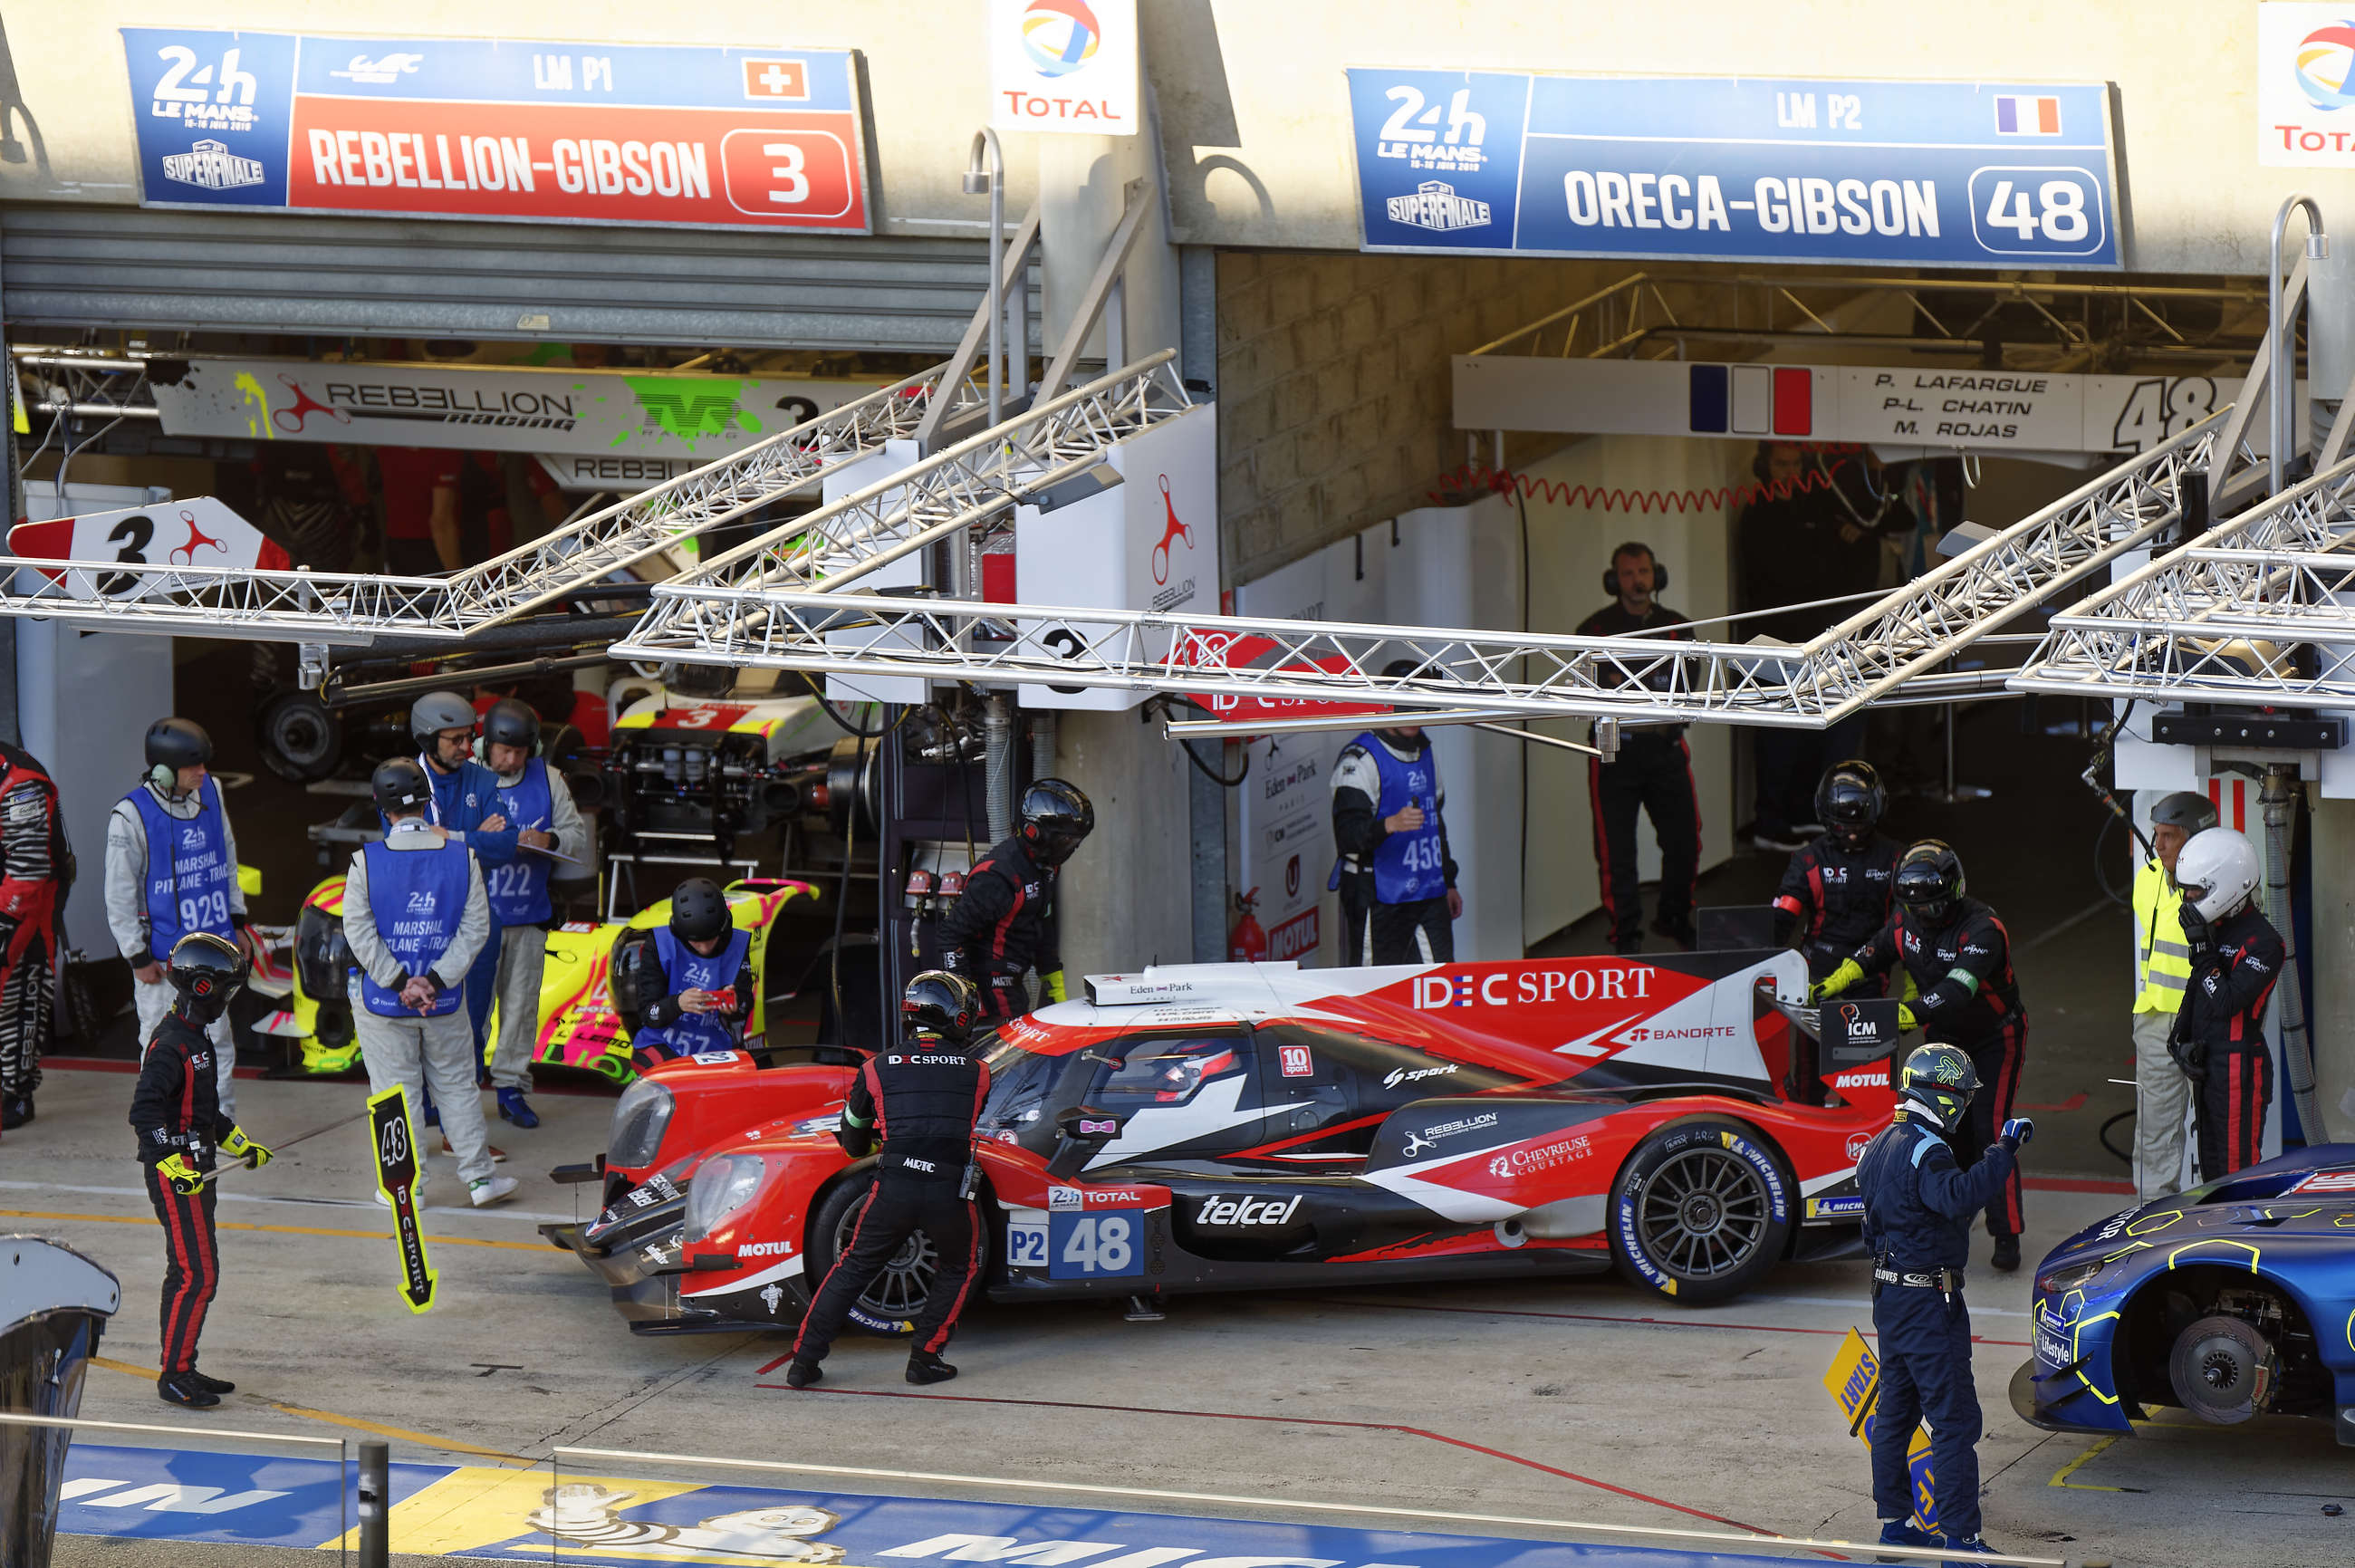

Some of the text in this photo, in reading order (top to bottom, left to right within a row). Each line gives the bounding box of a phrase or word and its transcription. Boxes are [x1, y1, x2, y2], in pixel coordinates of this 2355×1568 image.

[153, 45, 257, 105] 24h
[533, 54, 612, 92] LM P1
[152, 101, 254, 122] LE MANS
[1003, 91, 1121, 120] TOTAL
[1379, 85, 1486, 146] 24h
[1777, 92, 1862, 130] LM P2
[1377, 141, 1482, 162] LE MANS
[2274, 125, 2355, 151] TOT
[309, 129, 711, 199] REBELLION-GIBSON
[764, 143, 810, 204] 3
[1563, 170, 1940, 238] ORECA-GIBSON
[1985, 180, 2091, 243] 48
[1875, 373, 2049, 393] P. LAFARGUE
[325, 382, 574, 417] REBELLION
[1942, 399, 2033, 415] CHATIN
[2113, 375, 2217, 454] 48
[1894, 420, 2019, 438] M. ROJAS
[96, 515, 155, 595] 3
[677, 708, 719, 728] 3
[174, 851, 218, 875] MARSHAL
[1402, 834, 1443, 872] 458
[209, 861, 228, 883] TRAC
[179, 890, 228, 932] 929
[392, 919, 443, 936] MARSHAL
[1270, 915, 1318, 959] MOTUL
[1129, 983, 1194, 994] Eden Park
[1413, 967, 1656, 1009] IDEC SPORT
[1654, 1025, 1736, 1040] BANORTE
[1848, 1022, 1877, 1035] ICM
[888, 1054, 966, 1065] IDEC SPORT
[1283, 1049, 1308, 1067] 10
[1285, 1064, 1309, 1074] sport
[1405, 1063, 1459, 1082] spark
[1835, 1073, 1889, 1088] MOTUL
[1424, 1112, 1497, 1137] REBELLION
[381, 1116, 408, 1167] 48
[1512, 1135, 1591, 1167] CHEVREUSE
[903, 1157, 936, 1173] MRTC
[1517, 1148, 1593, 1176] COURTAGE
[1052, 1189, 1081, 1203] 24h
[1745, 1148, 1786, 1217] MICHELIN
[1084, 1191, 1141, 1203] TOTAL
[1197, 1195, 1303, 1227] telcel
[1832, 1202, 1866, 1211] MICH
[737, 1241, 793, 1257] MOTUL
[1011, 1230, 1045, 1261] P2
[1062, 1217, 1132, 1273] 48
[1621, 1203, 1658, 1277] MICHELIN
[406, 1232, 425, 1294] SPORT
[1875, 1267, 1899, 1284] GLOVES
[848, 1309, 889, 1331] MICHE
[2042, 1333, 2071, 1364] Lifestyle
[1841, 1352, 1877, 1417] START
